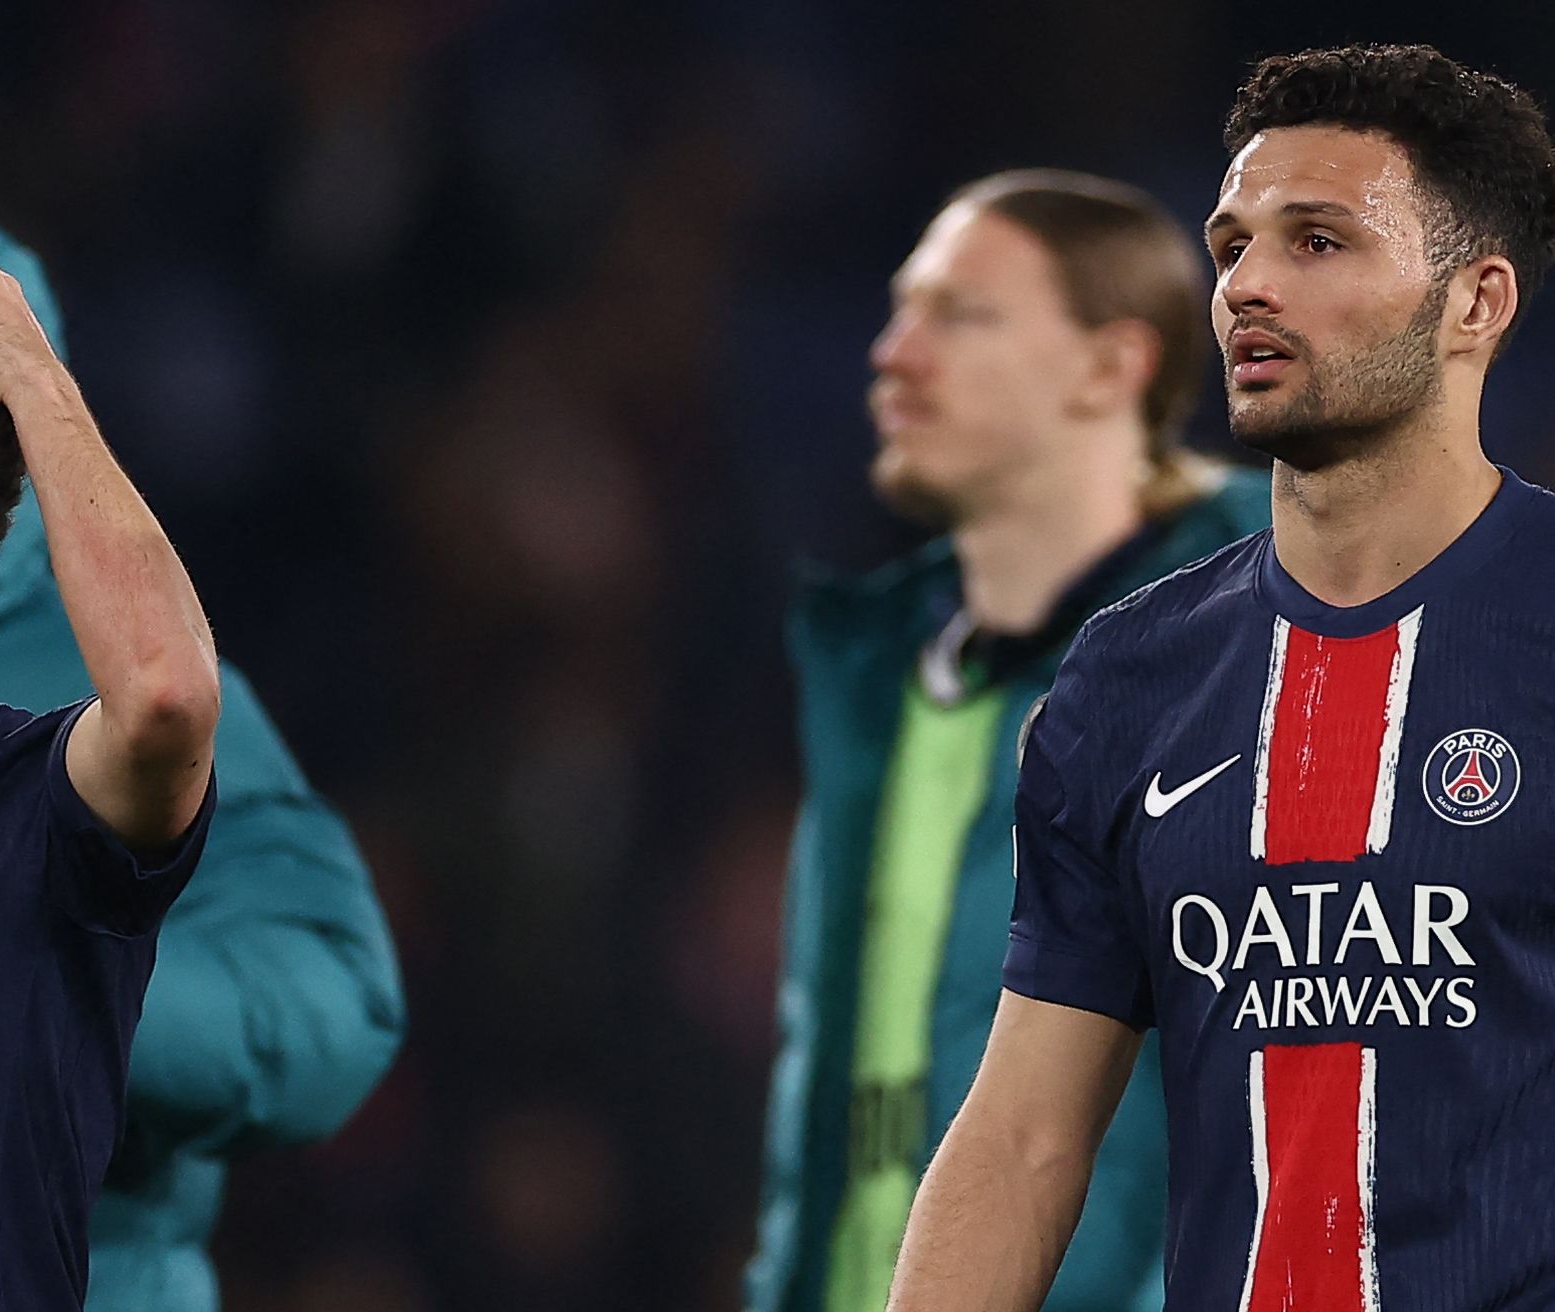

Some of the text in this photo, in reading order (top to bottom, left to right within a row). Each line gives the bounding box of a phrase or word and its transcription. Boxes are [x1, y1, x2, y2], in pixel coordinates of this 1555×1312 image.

[1443, 733, 1507, 759] PARIS
[1172, 881, 1477, 994] QATAR
[1232, 976, 1477, 1030] AIRWAYS
